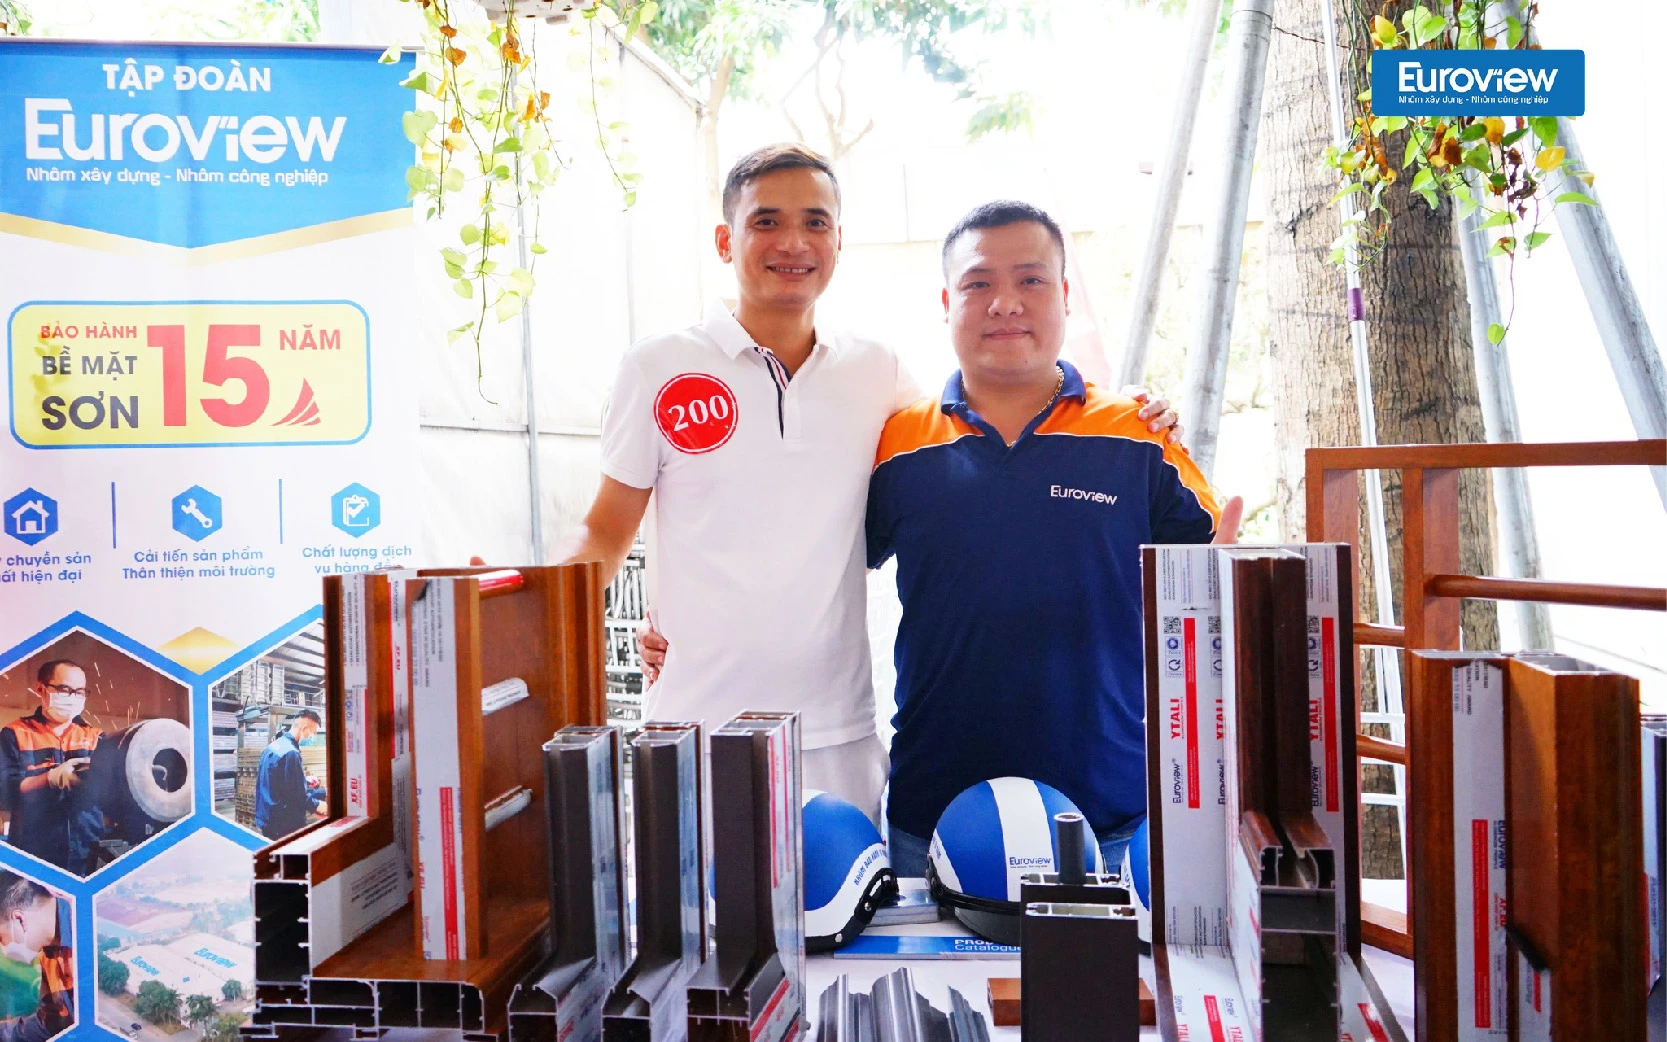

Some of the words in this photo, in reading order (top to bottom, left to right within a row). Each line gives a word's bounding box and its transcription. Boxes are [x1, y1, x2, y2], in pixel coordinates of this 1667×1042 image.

[103, 58, 164, 97] TẬP
[174, 59, 271, 92] ĐOÀN
[25, 98, 347, 163] Euroview
[26, 168, 76, 182] Nhôm
[81, 168, 110, 185] xây
[117, 167, 160, 186] dựng
[176, 168, 223, 182] Nhôm
[228, 168, 270, 187] công
[275, 168, 328, 187] nghiệp
[40, 320, 79, 339] BẢO
[85, 321, 138, 339] HÀNH
[279, 324, 341, 350] NĂM
[42, 345, 72, 375] BỀ
[81, 351, 138, 381] MẶT
[147, 324, 270, 427] 15
[41, 391, 139, 430] SƠN
[668, 395, 729, 432] 200
[1050, 485, 1118, 505] Euroview
[65, 551, 91, 564] sản
[134, 549, 158, 563] Cải
[163, 549, 188, 562] tiến
[193, 549, 217, 562] sản
[222, 545, 263, 563] phẩm
[302, 543, 335, 558] Chất
[339, 546, 378, 560] lượng
[382, 546, 412, 559] dịch
[21, 570, 52, 584] hiện
[58, 570, 82, 584] đại
[122, 567, 156, 579] Thân
[160, 566, 194, 580] thiện
[199, 565, 225, 577] môi
[229, 564, 275, 579] trường
[1170, 698, 1180, 740] YTALI
[1172, 761, 1181, 804] Euroview
[1009, 856, 1051, 866] Euroview
